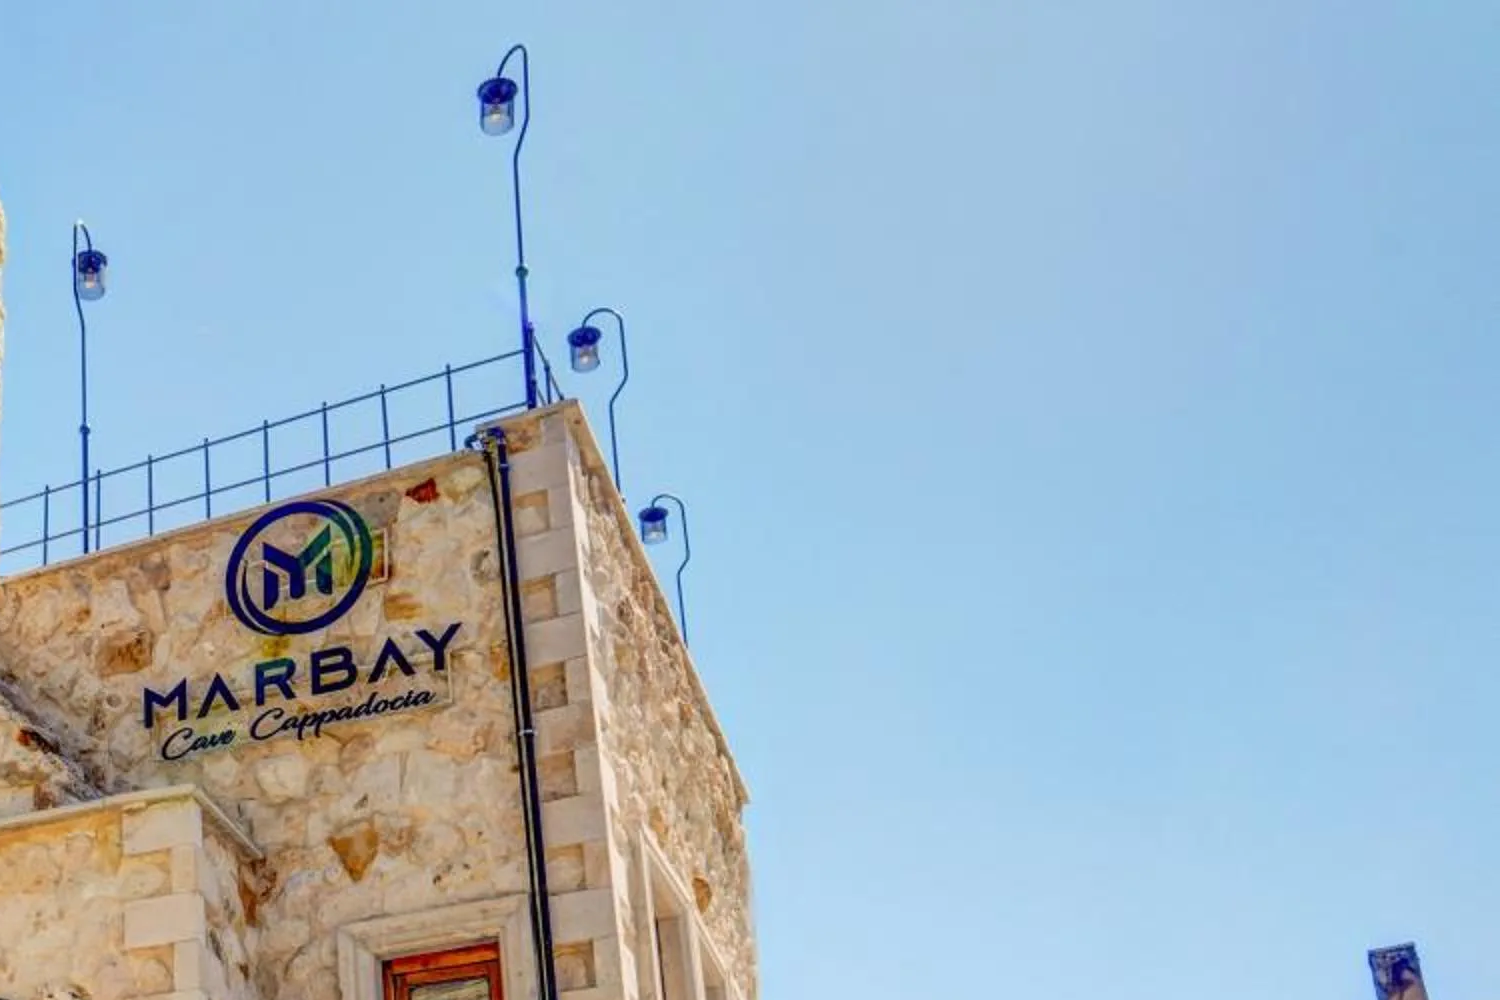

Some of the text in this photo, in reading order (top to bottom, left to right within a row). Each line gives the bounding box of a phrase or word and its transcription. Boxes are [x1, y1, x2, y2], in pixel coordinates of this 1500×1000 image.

[143, 622, 463, 729] MARBAY
[161, 689, 436, 761] Cave Cappadocia
